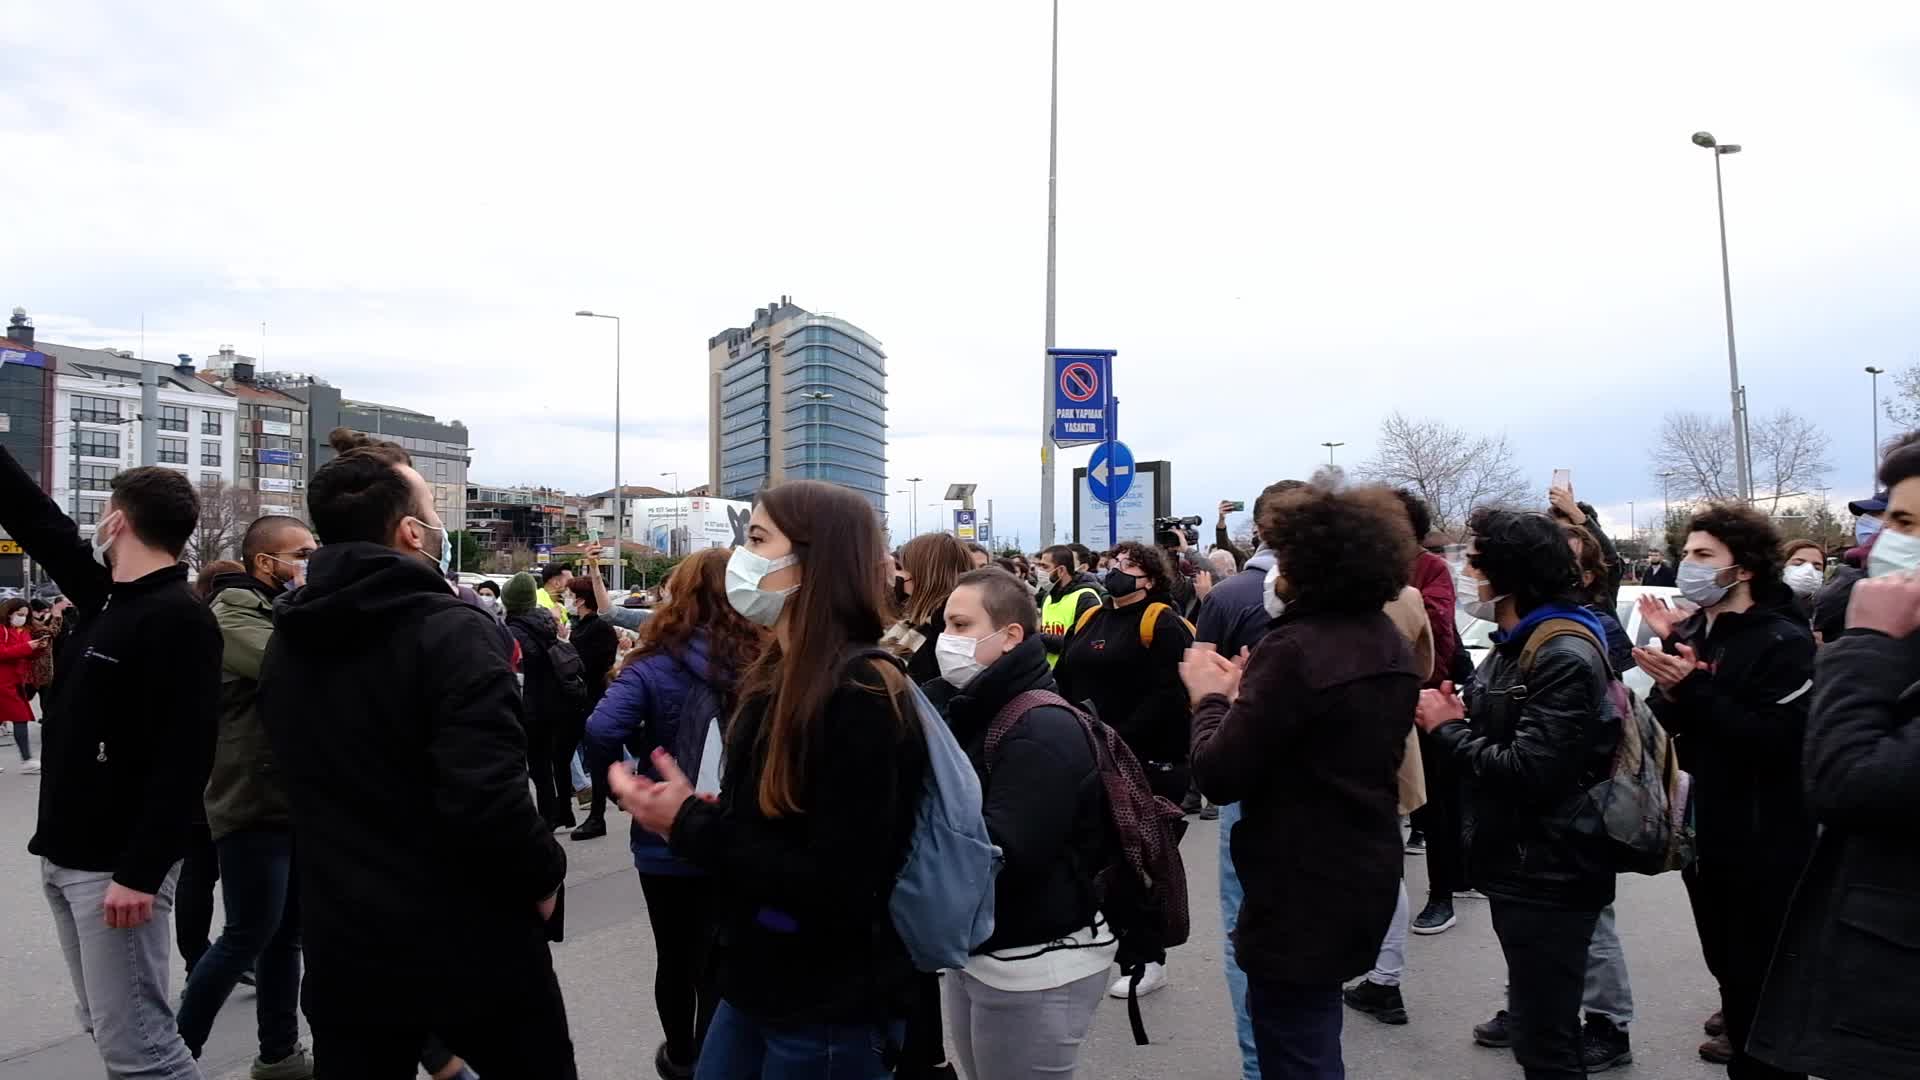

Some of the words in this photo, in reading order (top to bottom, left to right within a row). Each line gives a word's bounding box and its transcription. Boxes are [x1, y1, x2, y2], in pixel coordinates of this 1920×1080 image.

[1056, 408, 1074, 419] PARK
[1075, 408, 1103, 419] YAPMAK
[1064, 422, 1096, 433] YASAKTIR
